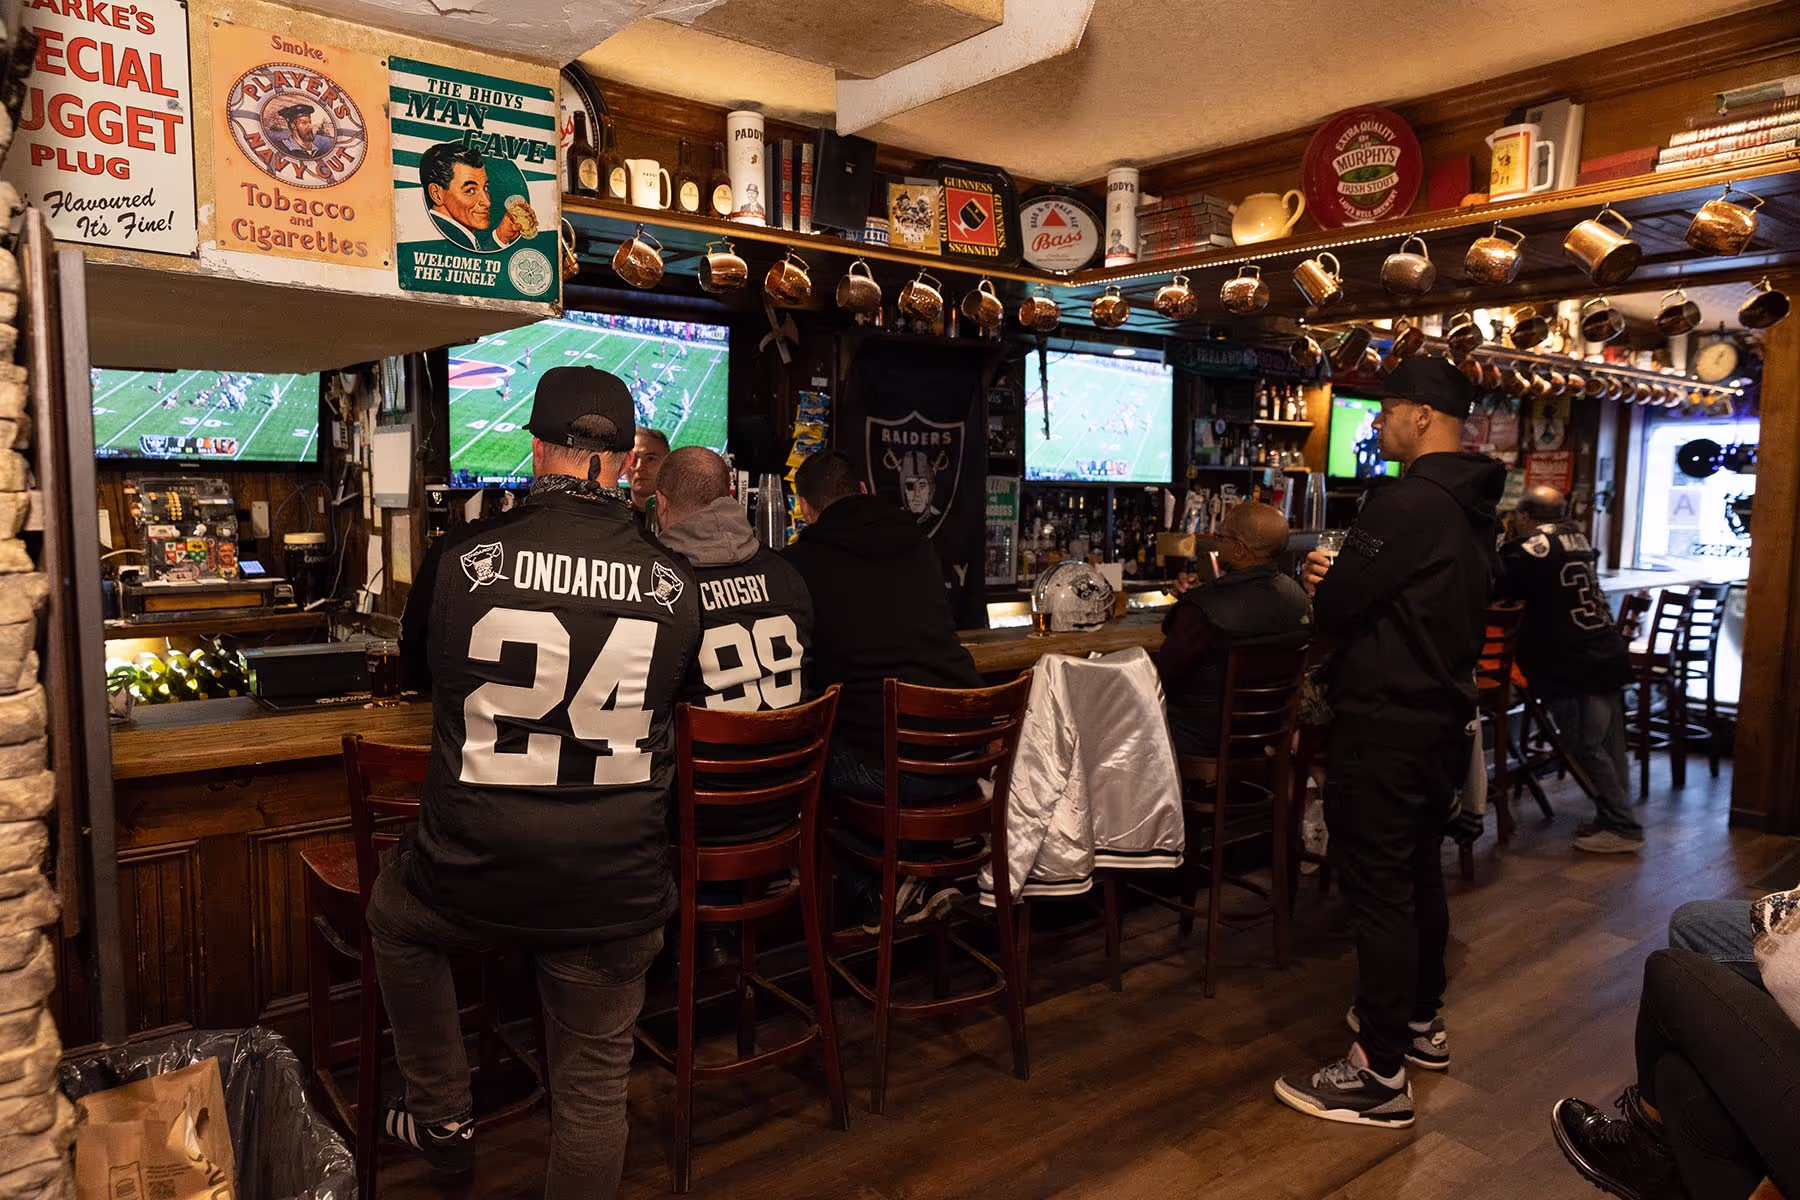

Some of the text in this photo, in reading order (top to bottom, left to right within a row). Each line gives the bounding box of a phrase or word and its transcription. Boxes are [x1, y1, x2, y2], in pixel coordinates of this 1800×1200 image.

[24, 0, 156, 35] ARKE'S
[242, 70, 351, 120] PLAYER'S
[405, 91, 489, 130] MAN
[428, 79, 524, 110] THE BHOYS
[462, 129, 550, 165] CAVE
[1335, 124, 1360, 151] EXTRA
[1359, 121, 1397, 142] QUALITY
[30, 143, 130, 180] PLUG
[244, 132, 356, 180] NAVY CUT
[944, 176, 993, 193] GUINNESS
[1341, 175, 1395, 194] IRISH STOUT
[43, 187, 156, 219] Flavoured
[240, 182, 355, 221] Tobacco
[76, 209, 175, 240] It's Fine!
[231, 217, 368, 258] Cigarettes
[289, 215, 314, 228] and
[1031, 230, 1083, 252] Bass
[413, 251, 501, 274] WELCOME TO
[414, 265, 497, 287] THE JUNGLE
[882, 428, 952, 446] RAIDERS
[1673, 493, 1695, 516] A
[513, 550, 643, 603] ONDAROX
[700, 574, 771, 612] CROSBY
[698, 614, 804, 712] 98
[459, 607, 658, 786] 24
